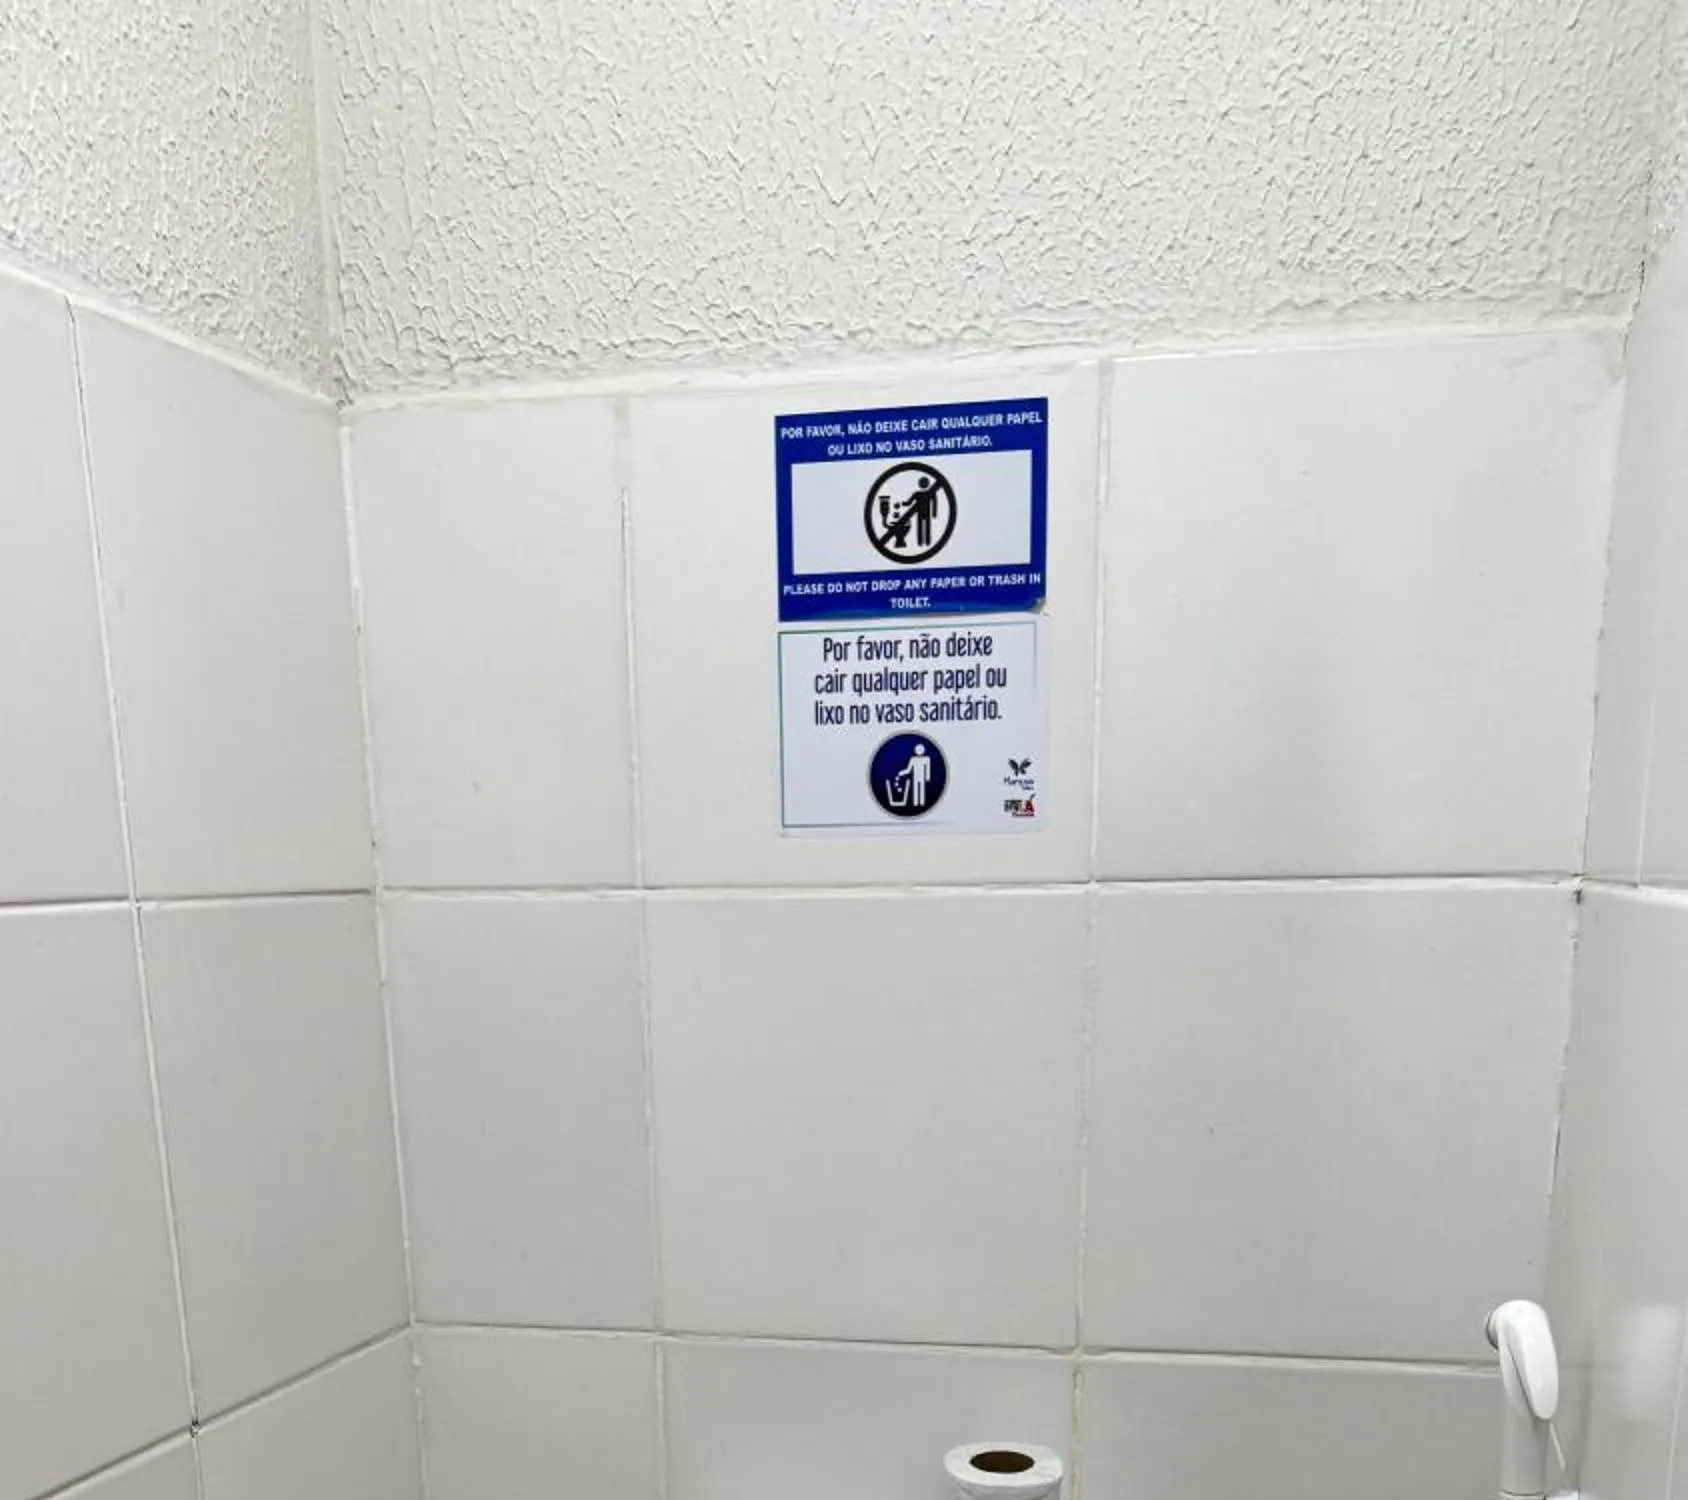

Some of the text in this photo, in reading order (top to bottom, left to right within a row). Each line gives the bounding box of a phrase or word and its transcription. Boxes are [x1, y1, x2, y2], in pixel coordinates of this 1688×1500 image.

[781, 412, 1042, 439] POR FAVOR, NÃO DEIXE CAIR QUALQUER PAPEL
[828, 435, 992, 456] OU LIXO NO VASO SANITÁRIO.
[784, 574, 1040, 595] PLEASE DO NOT DROP ANY PAPER OR TRASH IN
[889, 597, 931, 609] TOILET.
[824, 632, 993, 663] Por favor, não deixe
[815, 664, 1007, 697] cair qualquer papel ou
[815, 695, 1002, 725] lixo no vaso sanitário.
